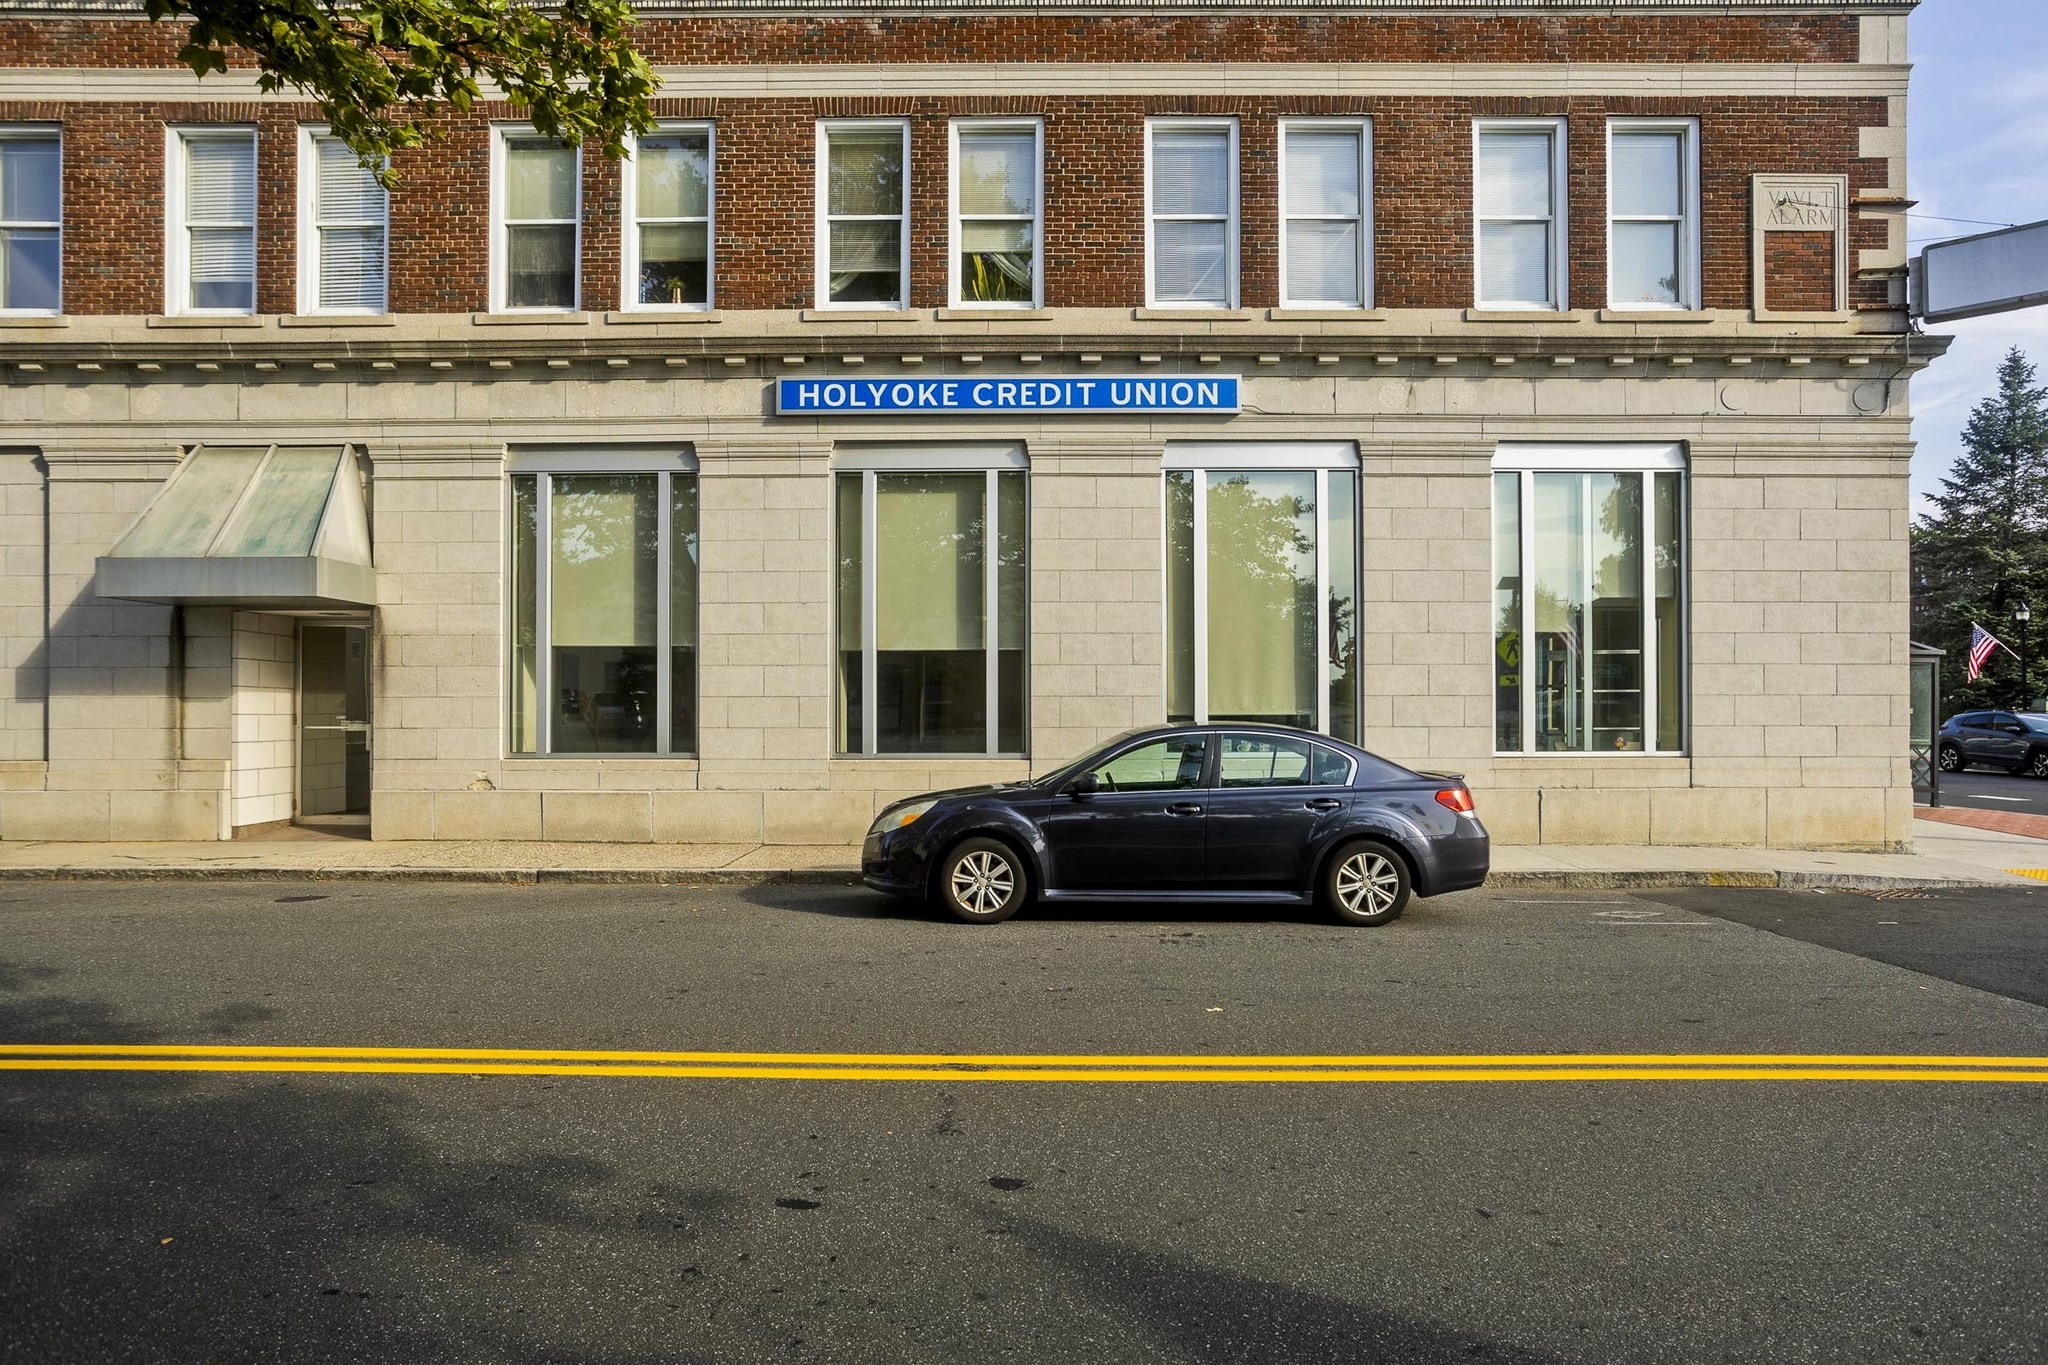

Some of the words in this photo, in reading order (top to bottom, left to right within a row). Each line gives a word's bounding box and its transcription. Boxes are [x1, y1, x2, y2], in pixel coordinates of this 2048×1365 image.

[1766, 208, 1833, 225] ALARM
[799, 383, 959, 407] HOLYOKE
[972, 383, 1096, 406] CREDIT
[1111, 382, 1219, 405] UNION
